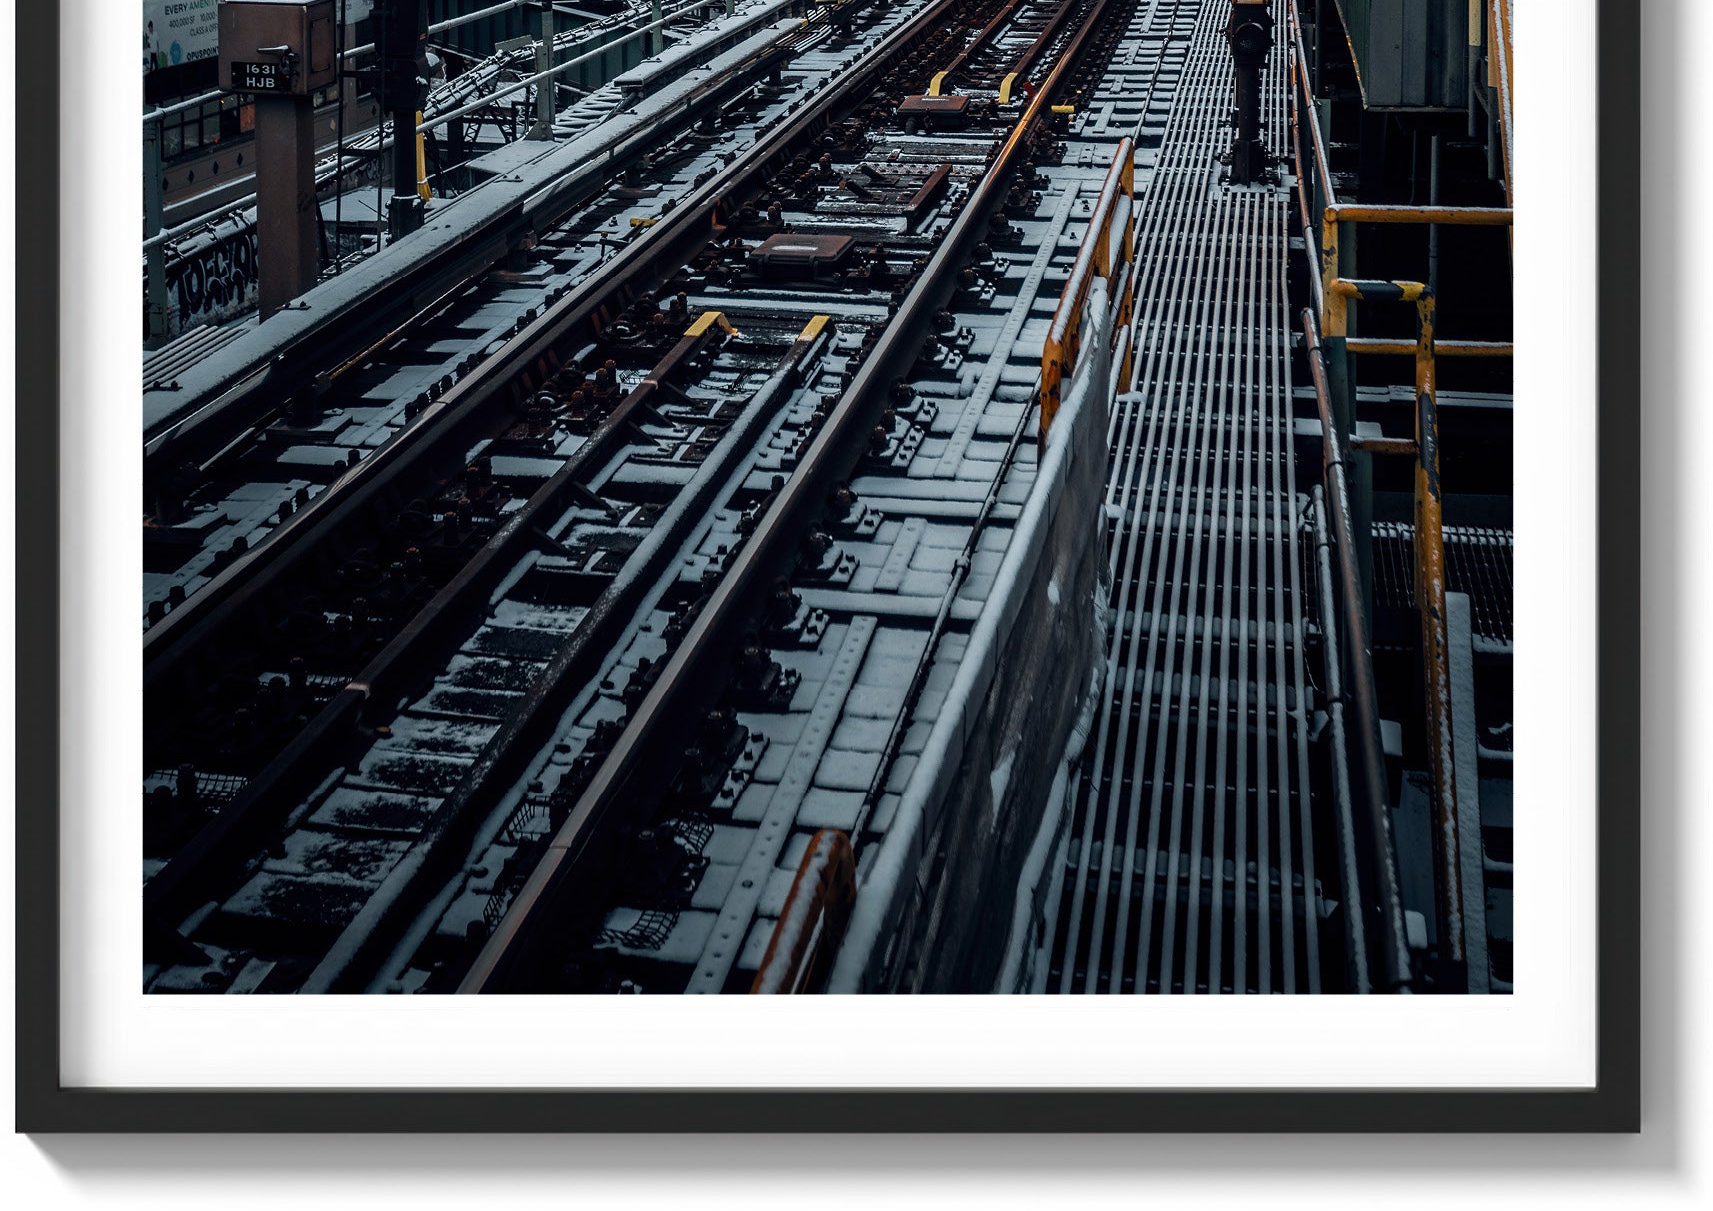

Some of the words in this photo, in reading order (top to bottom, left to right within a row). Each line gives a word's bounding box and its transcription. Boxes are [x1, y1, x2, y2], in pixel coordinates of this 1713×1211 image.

[165, 3, 188, 15] EVERY
[246, 63, 275, 75] 1631
[246, 77, 275, 88] HJB
